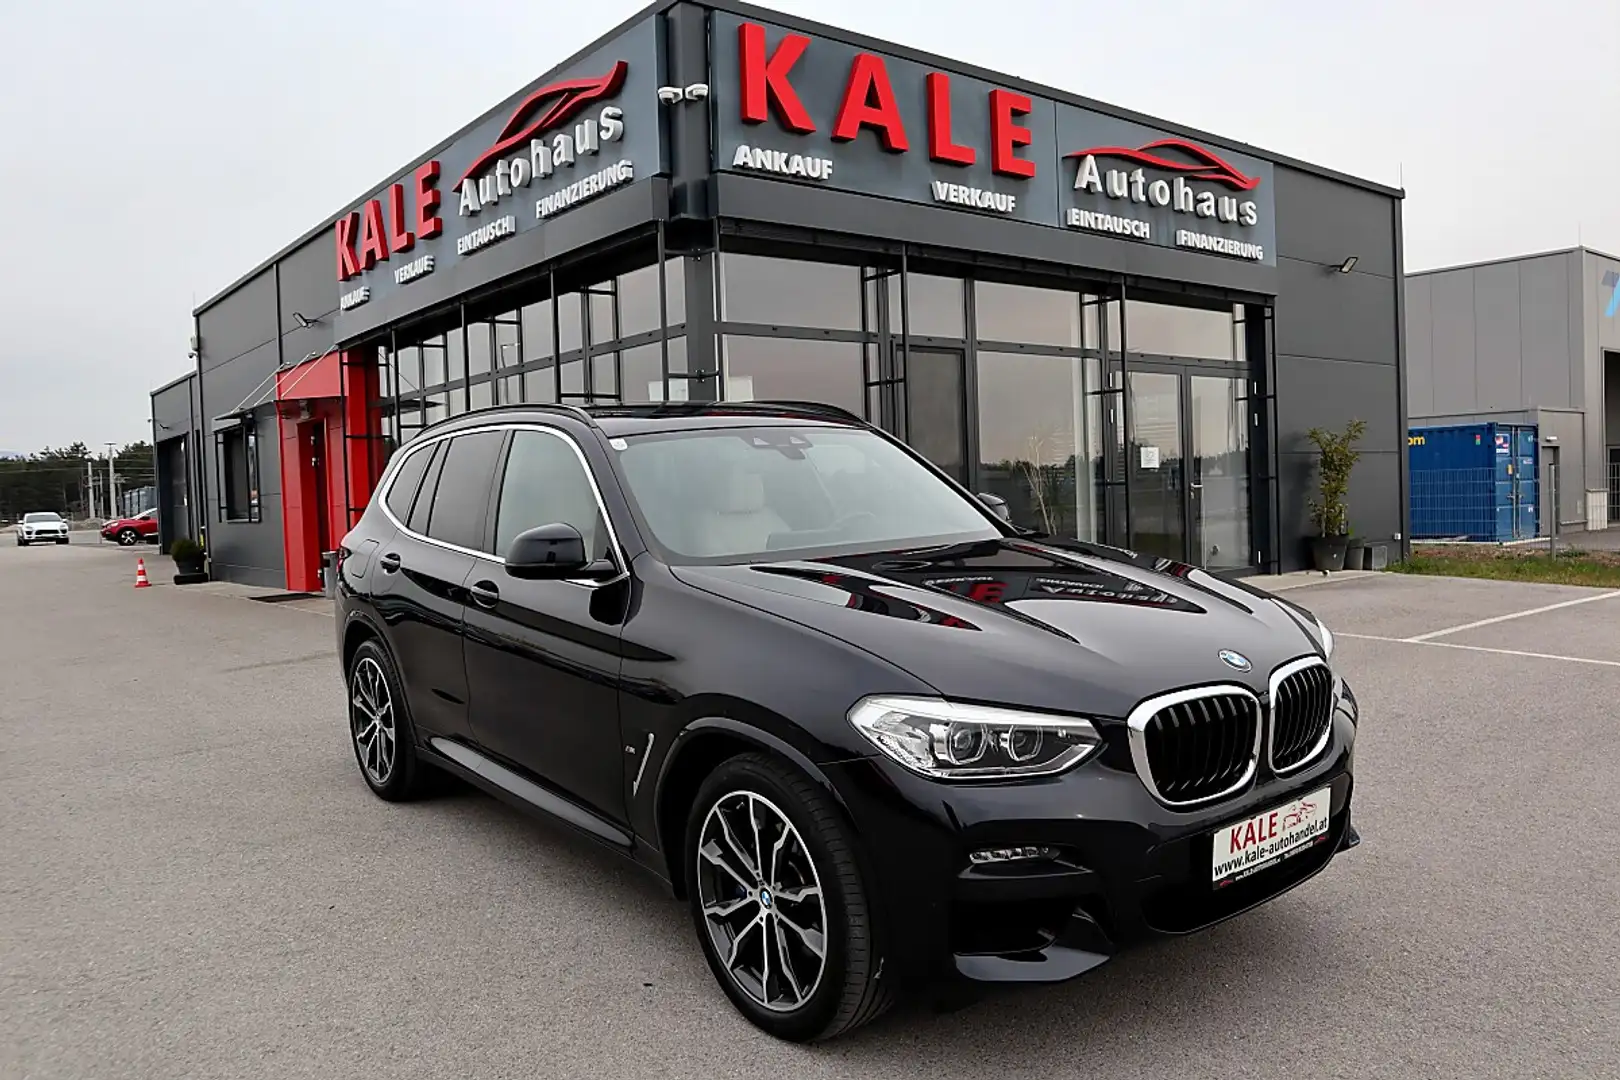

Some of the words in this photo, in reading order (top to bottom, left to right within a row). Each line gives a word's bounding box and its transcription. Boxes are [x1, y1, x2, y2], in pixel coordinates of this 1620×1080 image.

[738, 22, 1035, 179] KALE
[459, 106, 624, 216] Autohaus
[732, 145, 833, 180] ANKAUF
[536, 159, 634, 218] FINANZIERUNG
[930, 180, 1016, 213] VERKAUF
[1073, 154, 1258, 226] Autohaus
[334, 160, 442, 281] KALE
[457, 215, 516, 255] EINTAUSCH
[1066, 208, 1150, 239] EINTAUSCH
[1176, 229, 1264, 260] FINANZIERUNG
[1214, 817, 1328, 877] www.kale-autohandel.at
[1229, 812, 1279, 854] KALE
